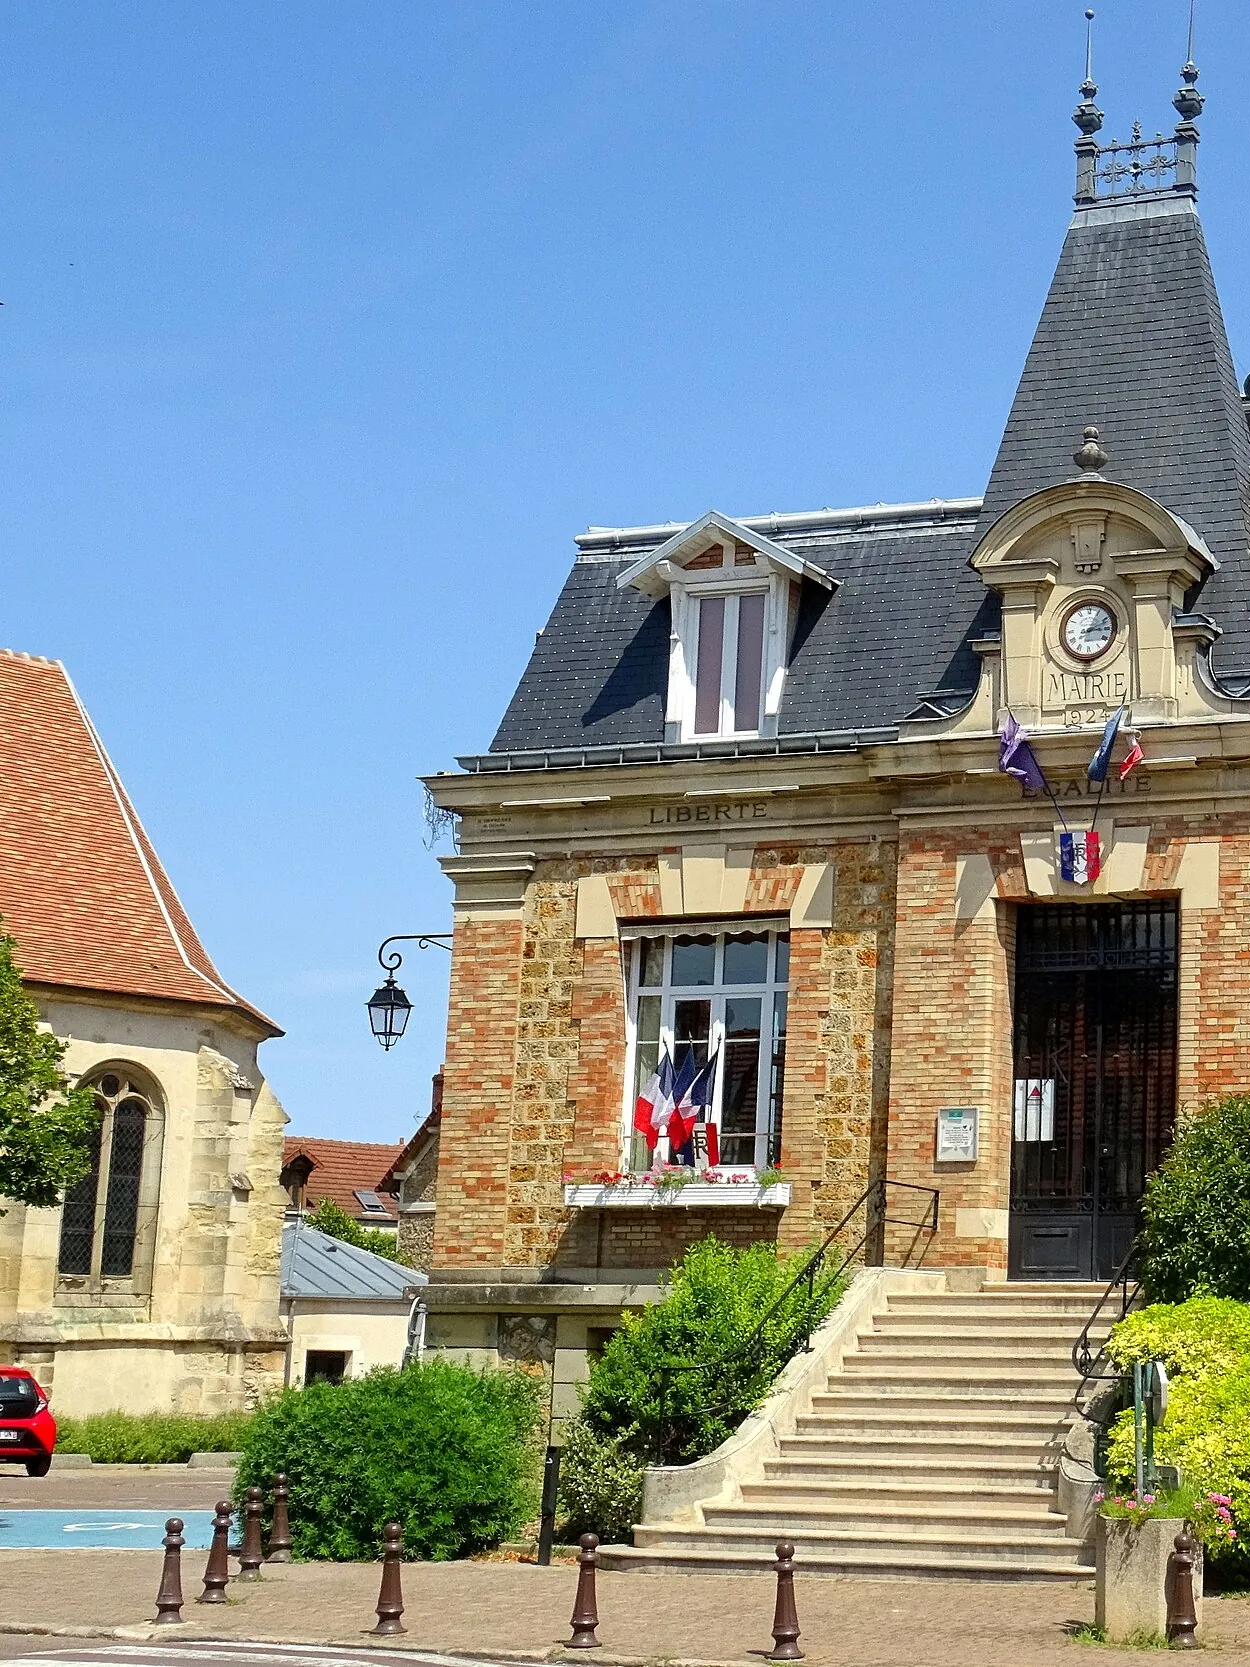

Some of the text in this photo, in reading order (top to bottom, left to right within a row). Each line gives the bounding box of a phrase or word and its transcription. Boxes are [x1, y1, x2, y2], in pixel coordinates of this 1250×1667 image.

[1047, 673, 1126, 701] MAIRIE
[1062, 708, 1111, 725] 1924
[649, 802, 768, 824] LIBERTE
